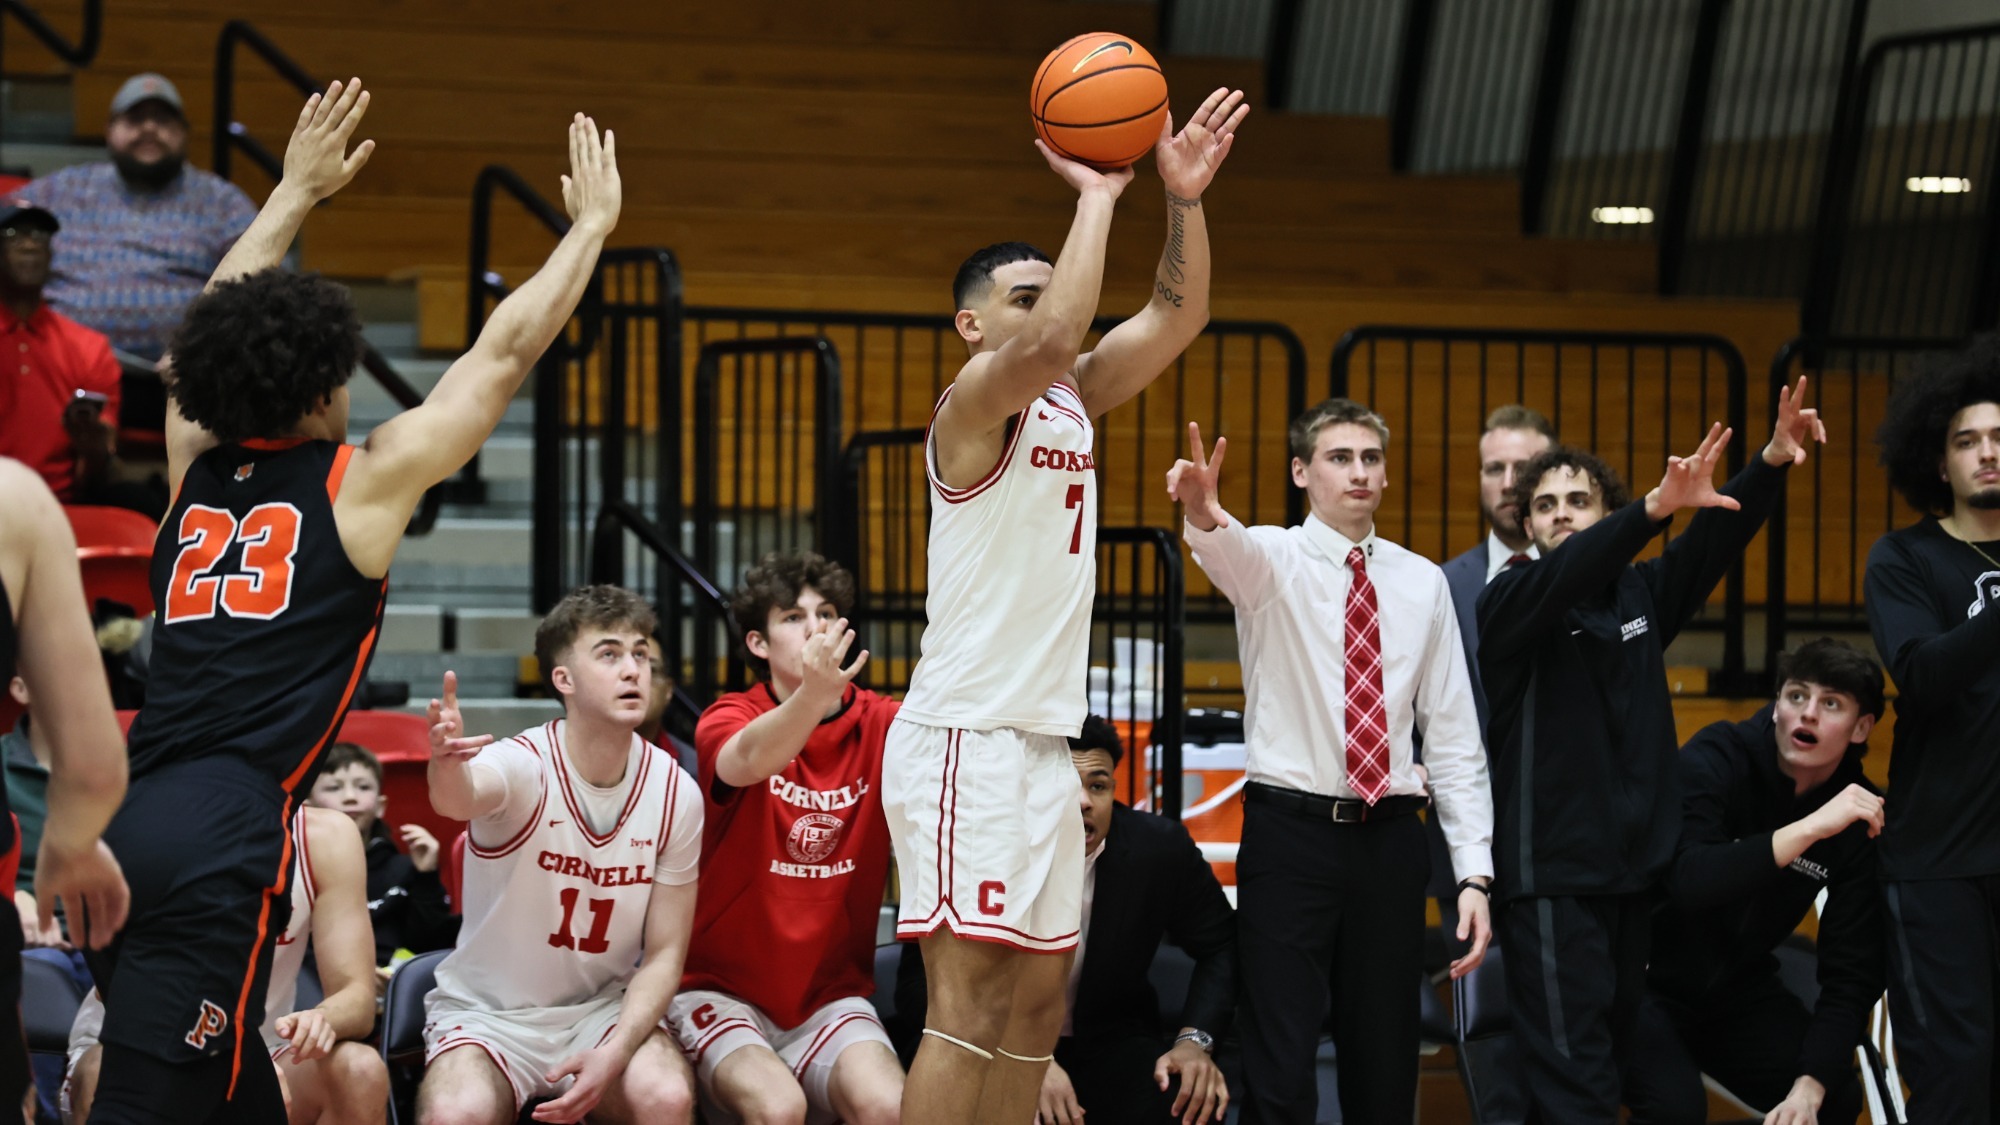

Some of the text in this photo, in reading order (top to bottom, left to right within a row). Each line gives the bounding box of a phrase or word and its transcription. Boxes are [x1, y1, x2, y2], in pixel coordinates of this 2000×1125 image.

[1154, 273, 1185, 308] 200
[1065, 484, 1085, 555] 7
[165, 502, 303, 625] 23
[769, 774, 870, 812] CORNELL
[547, 887, 615, 954] 11
[977, 880, 1006, 917] C
[184, 998, 228, 1050] P
[691, 1003, 718, 1031] C
